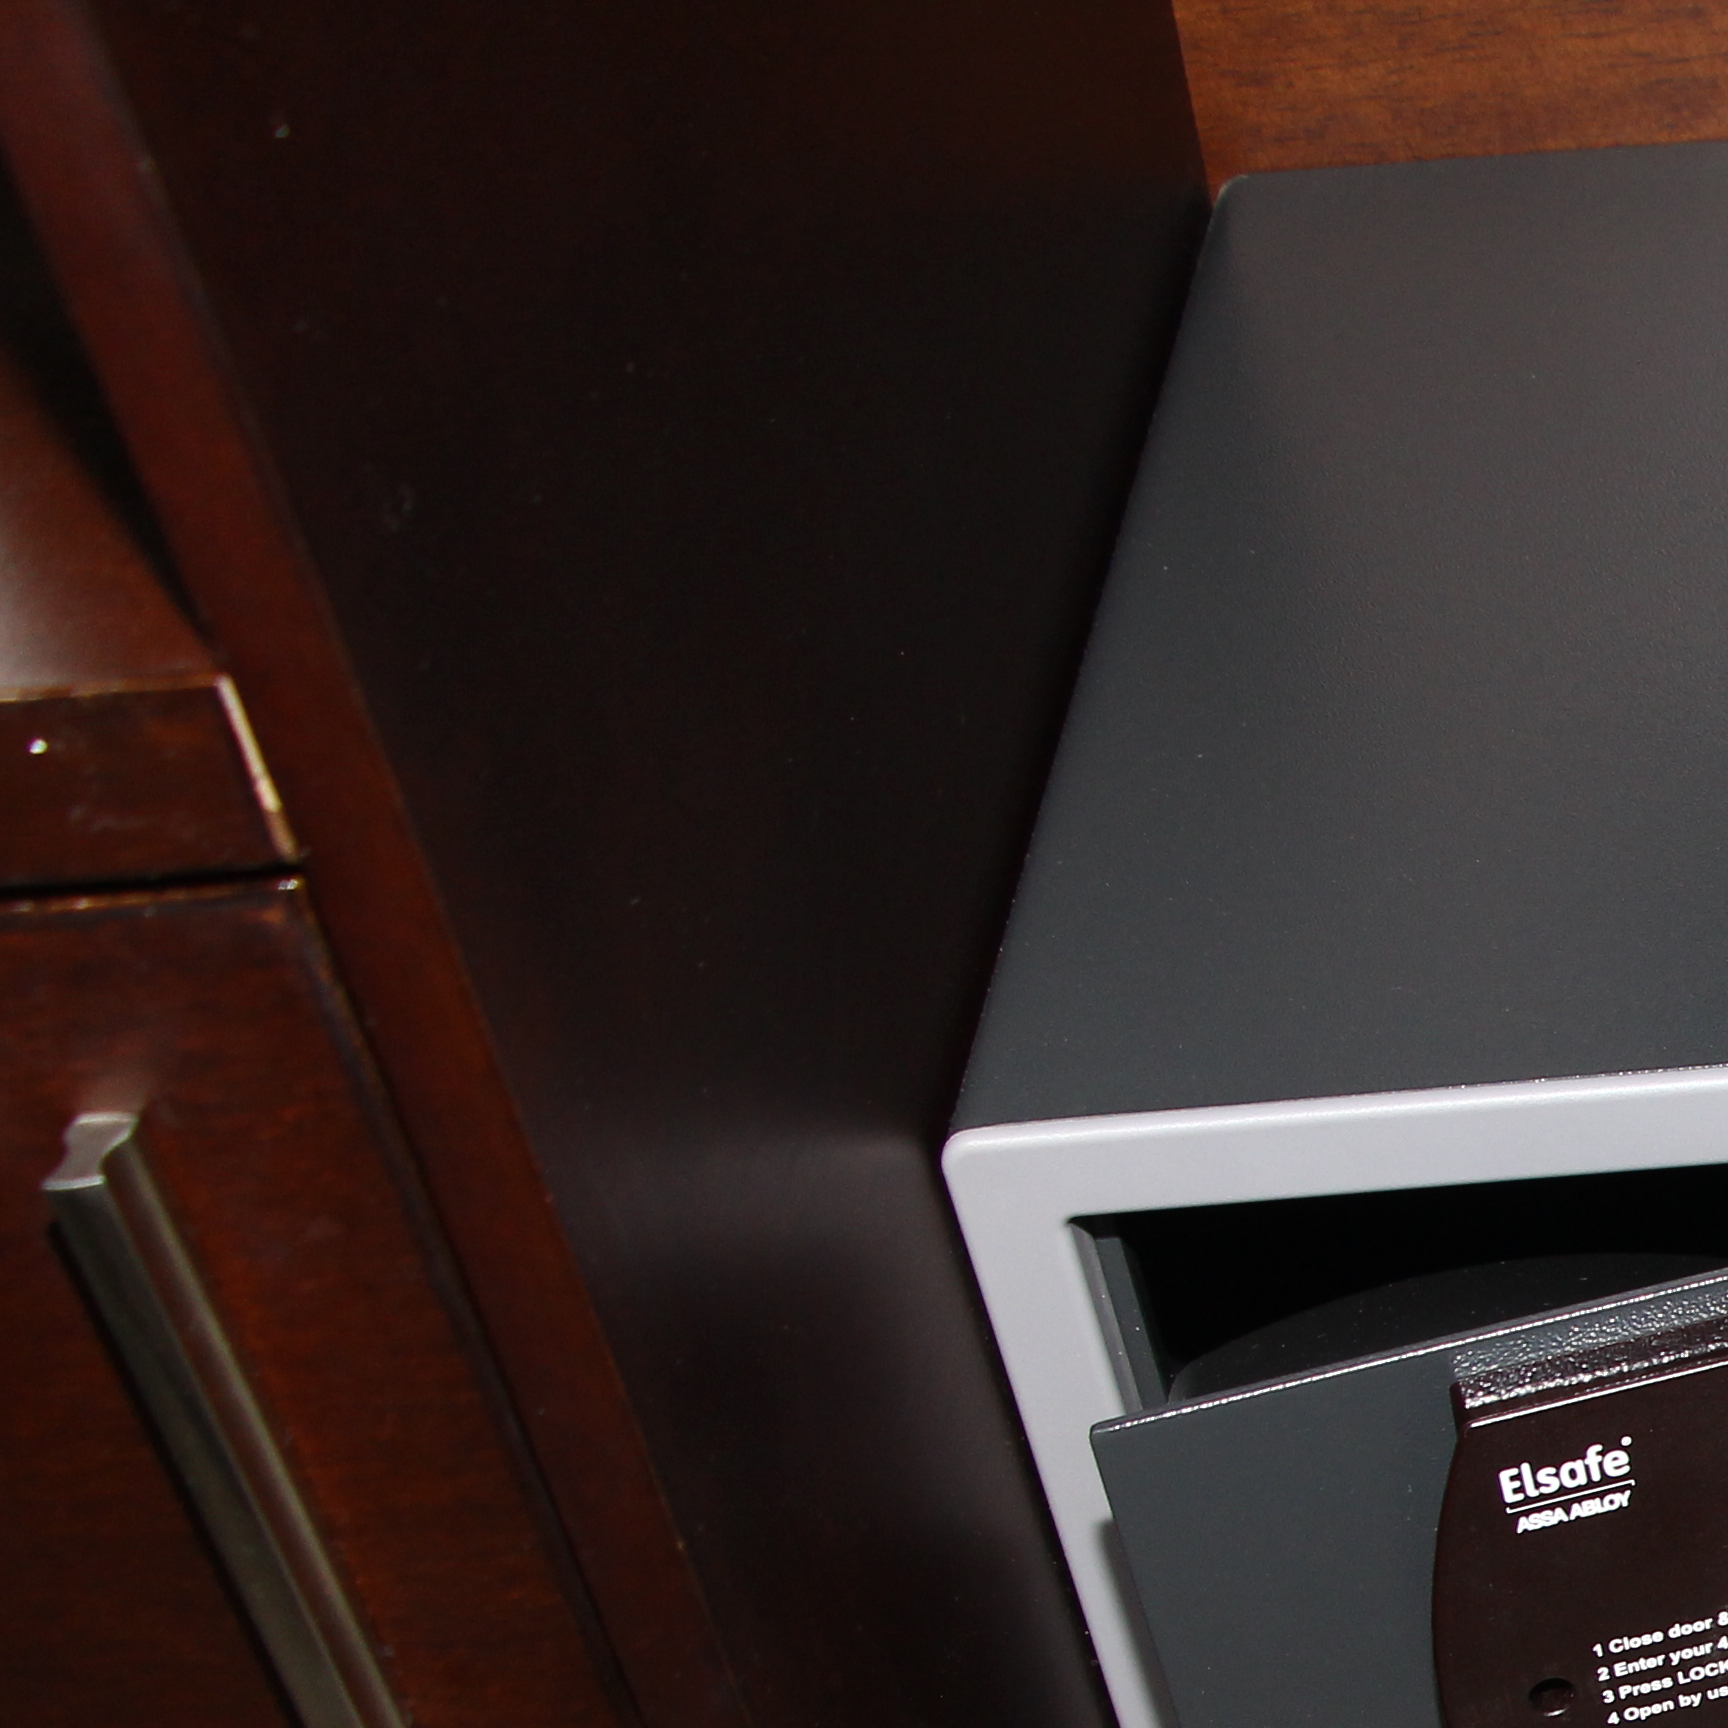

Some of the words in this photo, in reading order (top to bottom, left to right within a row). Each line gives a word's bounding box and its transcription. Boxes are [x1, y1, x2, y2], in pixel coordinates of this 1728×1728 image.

[1499, 1443, 1632, 1504] Elsafe
[1516, 1506, 1568, 1534] ASSA
[1567, 1490, 1632, 1521] ABLOY
[1592, 1643, 1604, 1658] 1
[1608, 1630, 1664, 1654] Close
[1667, 1617, 1714, 1639] door
[1597, 1666, 1611, 1682] 2
[1613, 1654, 1666, 1678] Enter
[1668, 1642, 1714, 1666] your
[1602, 1689, 1615, 1704] 3
[1618, 1676, 1674, 1700] Press
[1607, 1711, 1620, 1725] 4
[1623, 1700, 1675, 1721] Open
[1677, 1692, 1702, 1708] by
